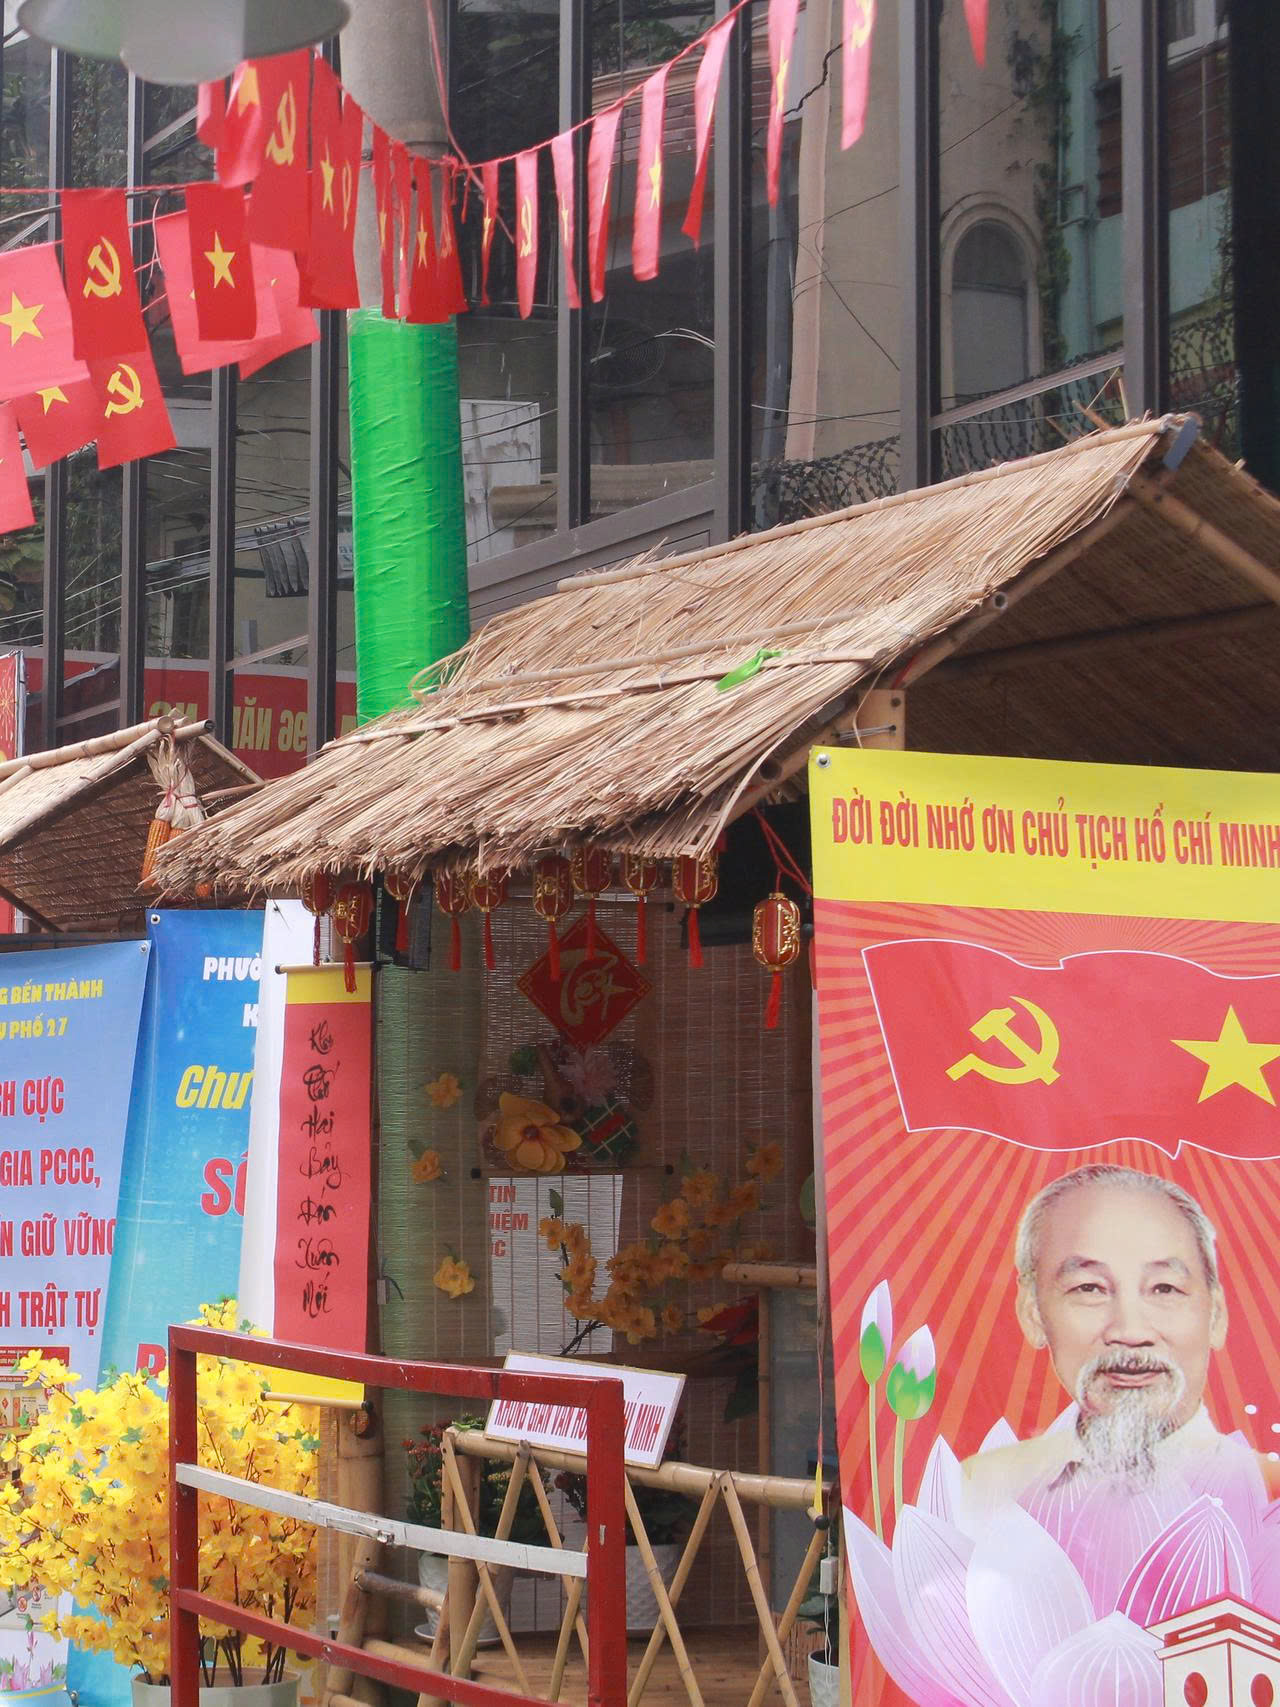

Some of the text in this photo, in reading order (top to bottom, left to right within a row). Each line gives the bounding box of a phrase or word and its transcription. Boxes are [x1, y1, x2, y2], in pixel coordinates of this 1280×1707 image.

[832, 787, 1280, 869] ĐỜI ĐỜI NHỚ ƠN CHỦ TỊCH HỒ CHÍ MINH
[11, 978, 42, 1004] BẾN
[45, 977, 104, 1001] THÀNH
[10, 1012, 44, 1040] PHỐ
[47, 1016, 69, 1037] 27
[23, 1076, 64, 1123] CỰC
[0, 1150, 33, 1186] GIA
[40, 1148, 100, 1188] PCCC,
[21, 1212, 57, 1256] GIỮ
[18, 1283, 68, 1335] TRẬT
[75, 1288, 101, 1335] TỰ
